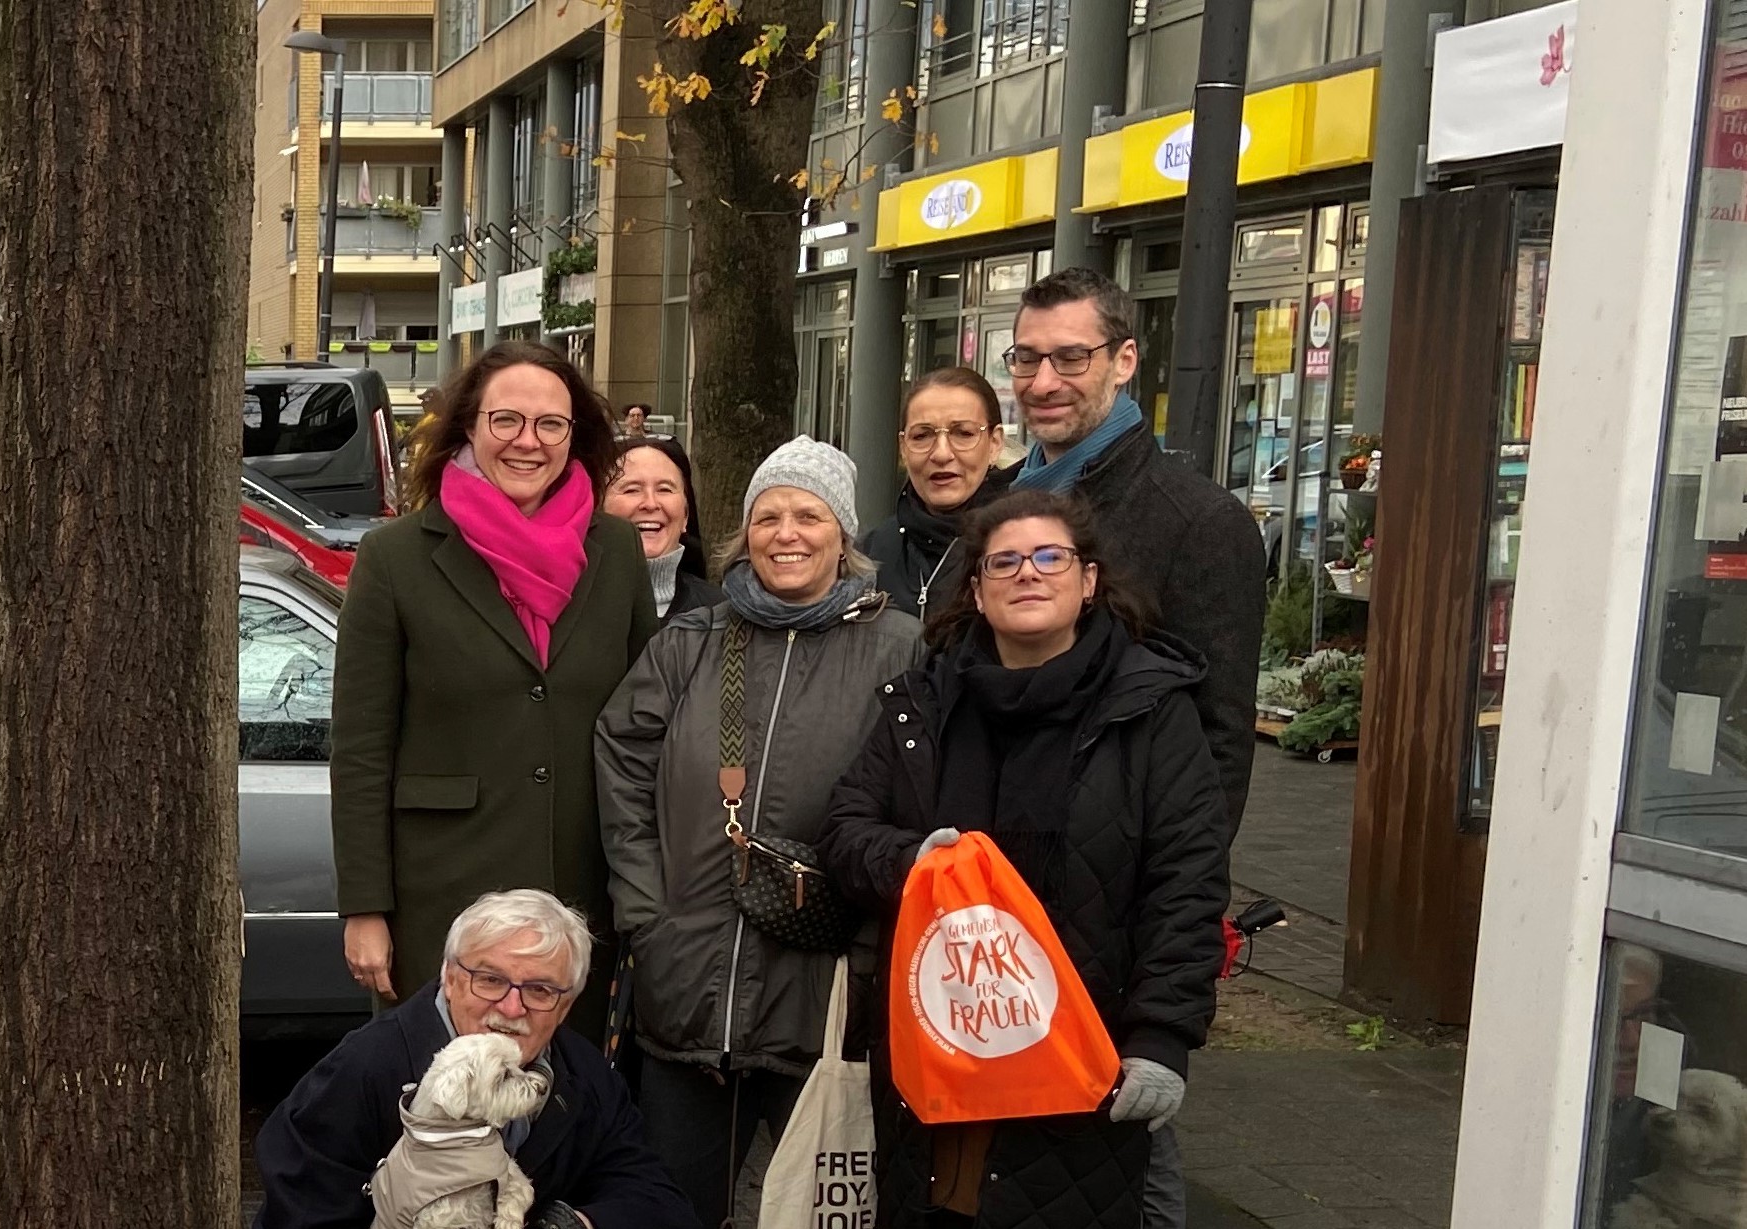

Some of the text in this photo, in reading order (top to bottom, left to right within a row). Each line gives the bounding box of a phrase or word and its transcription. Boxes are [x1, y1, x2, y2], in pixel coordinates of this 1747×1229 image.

[1307, 350, 1330, 366] LAST
[941, 931, 1035, 987] STARK
[976, 979, 1005, 999] FÜR
[949, 986, 1040, 1043] FRAUEN
[813, 1181, 868, 1207] JOY.
